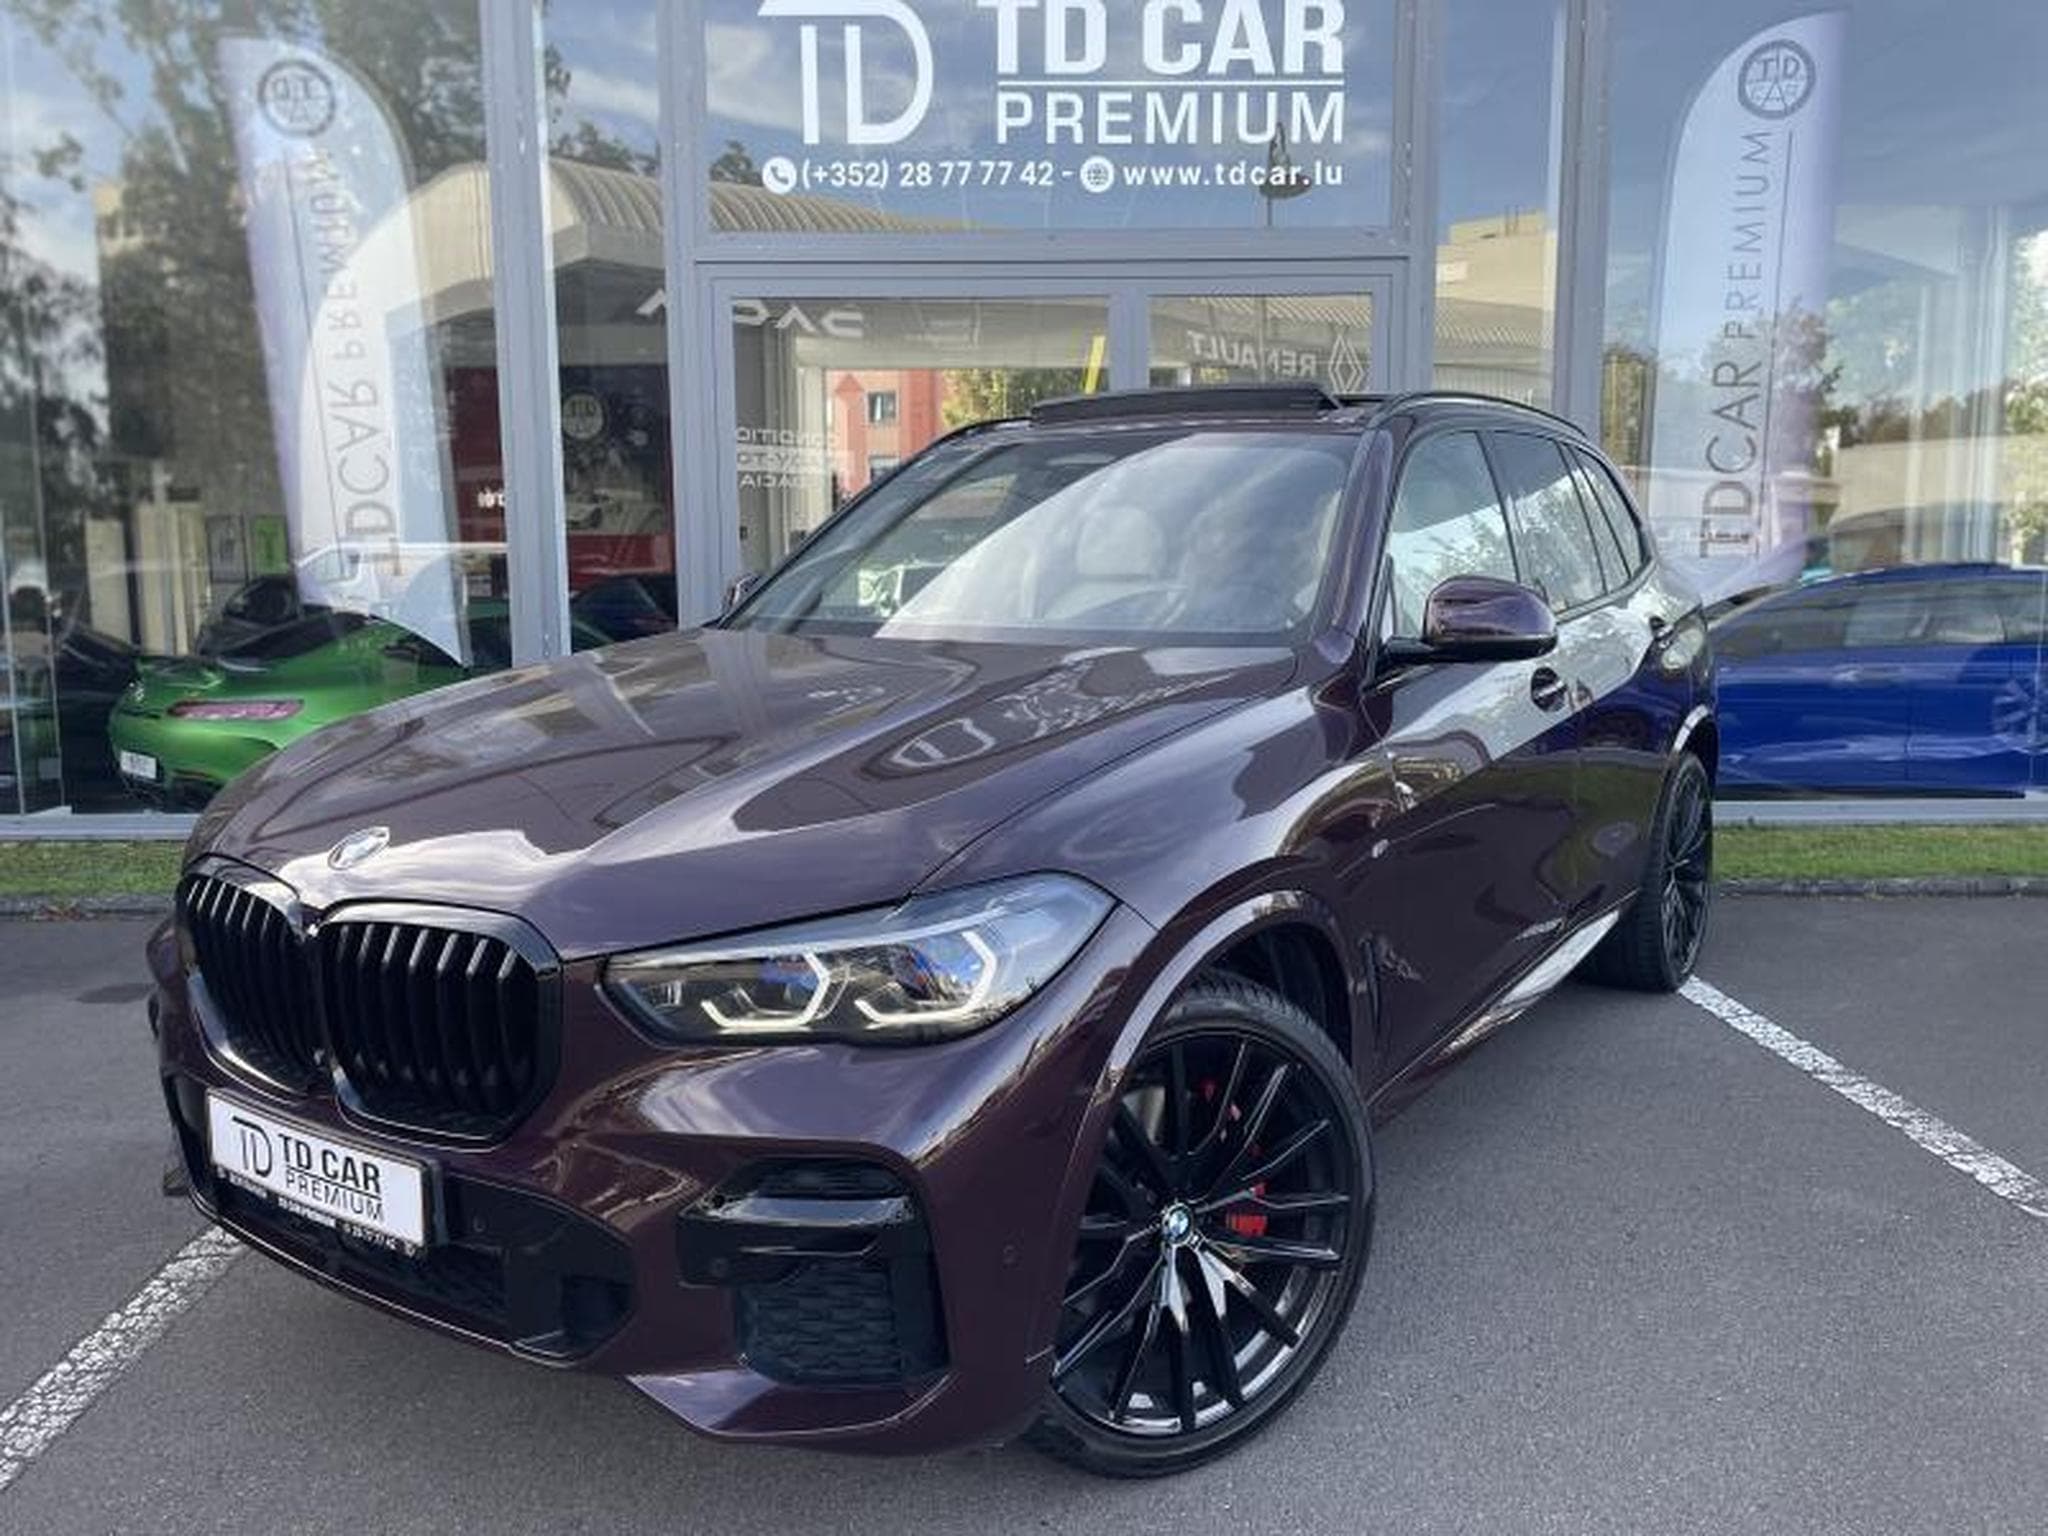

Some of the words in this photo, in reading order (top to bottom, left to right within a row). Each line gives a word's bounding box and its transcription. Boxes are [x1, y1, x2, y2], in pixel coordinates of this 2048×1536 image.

[976, 0, 1108, 75] TD
[1142, 0, 1345, 76] CAR
[997, 91, 1345, 145] PREMIUM
[802, 158, 889, 189] (+352)
[900, 161, 932, 187] 28
[938, 161, 971, 187] 77
[980, 161, 1013, 187] 77
[1019, 161, 1055, 186] 42
[1122, 160, 1343, 187] www.tdcar.lu
[1723, 130, 1773, 342] PREMIUM
[278, 1132, 312, 1171] TD
[321, 1149, 382, 1195] CAR
[285, 1170, 385, 1223] PREMIUM
